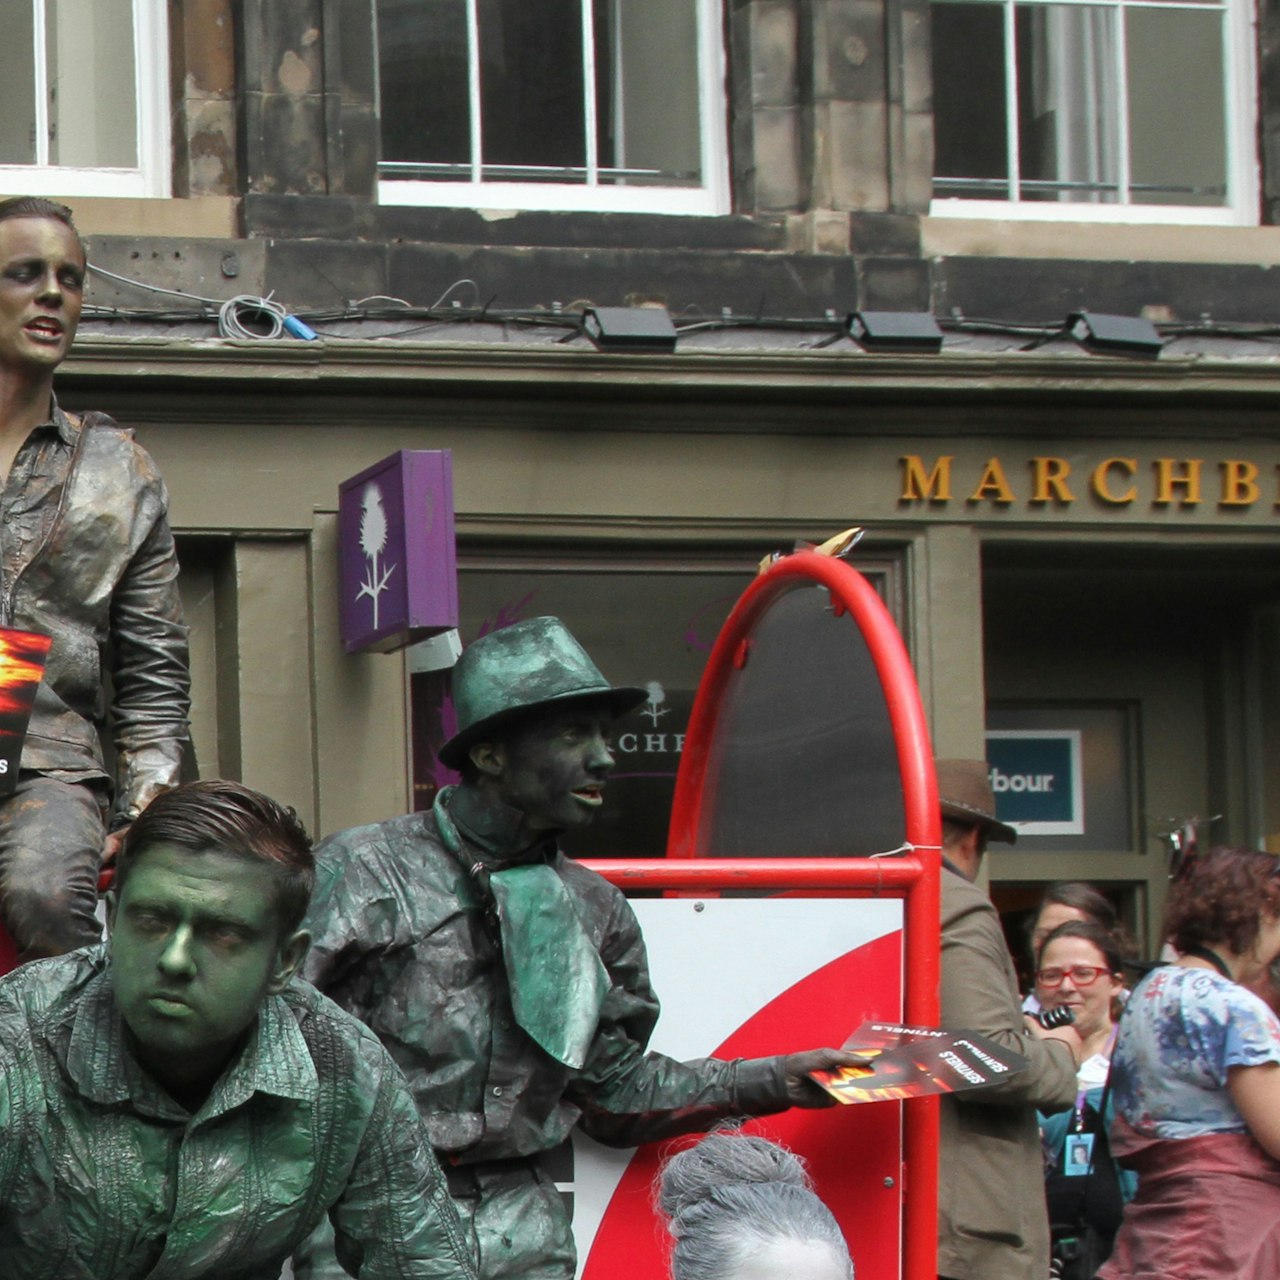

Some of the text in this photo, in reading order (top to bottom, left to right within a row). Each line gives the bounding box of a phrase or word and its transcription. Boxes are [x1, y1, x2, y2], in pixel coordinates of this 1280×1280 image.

[898, 455, 1280, 505] MARCHB
[988, 768, 1053, 792] bour
[871, 1025, 947, 1037] NTINELS
